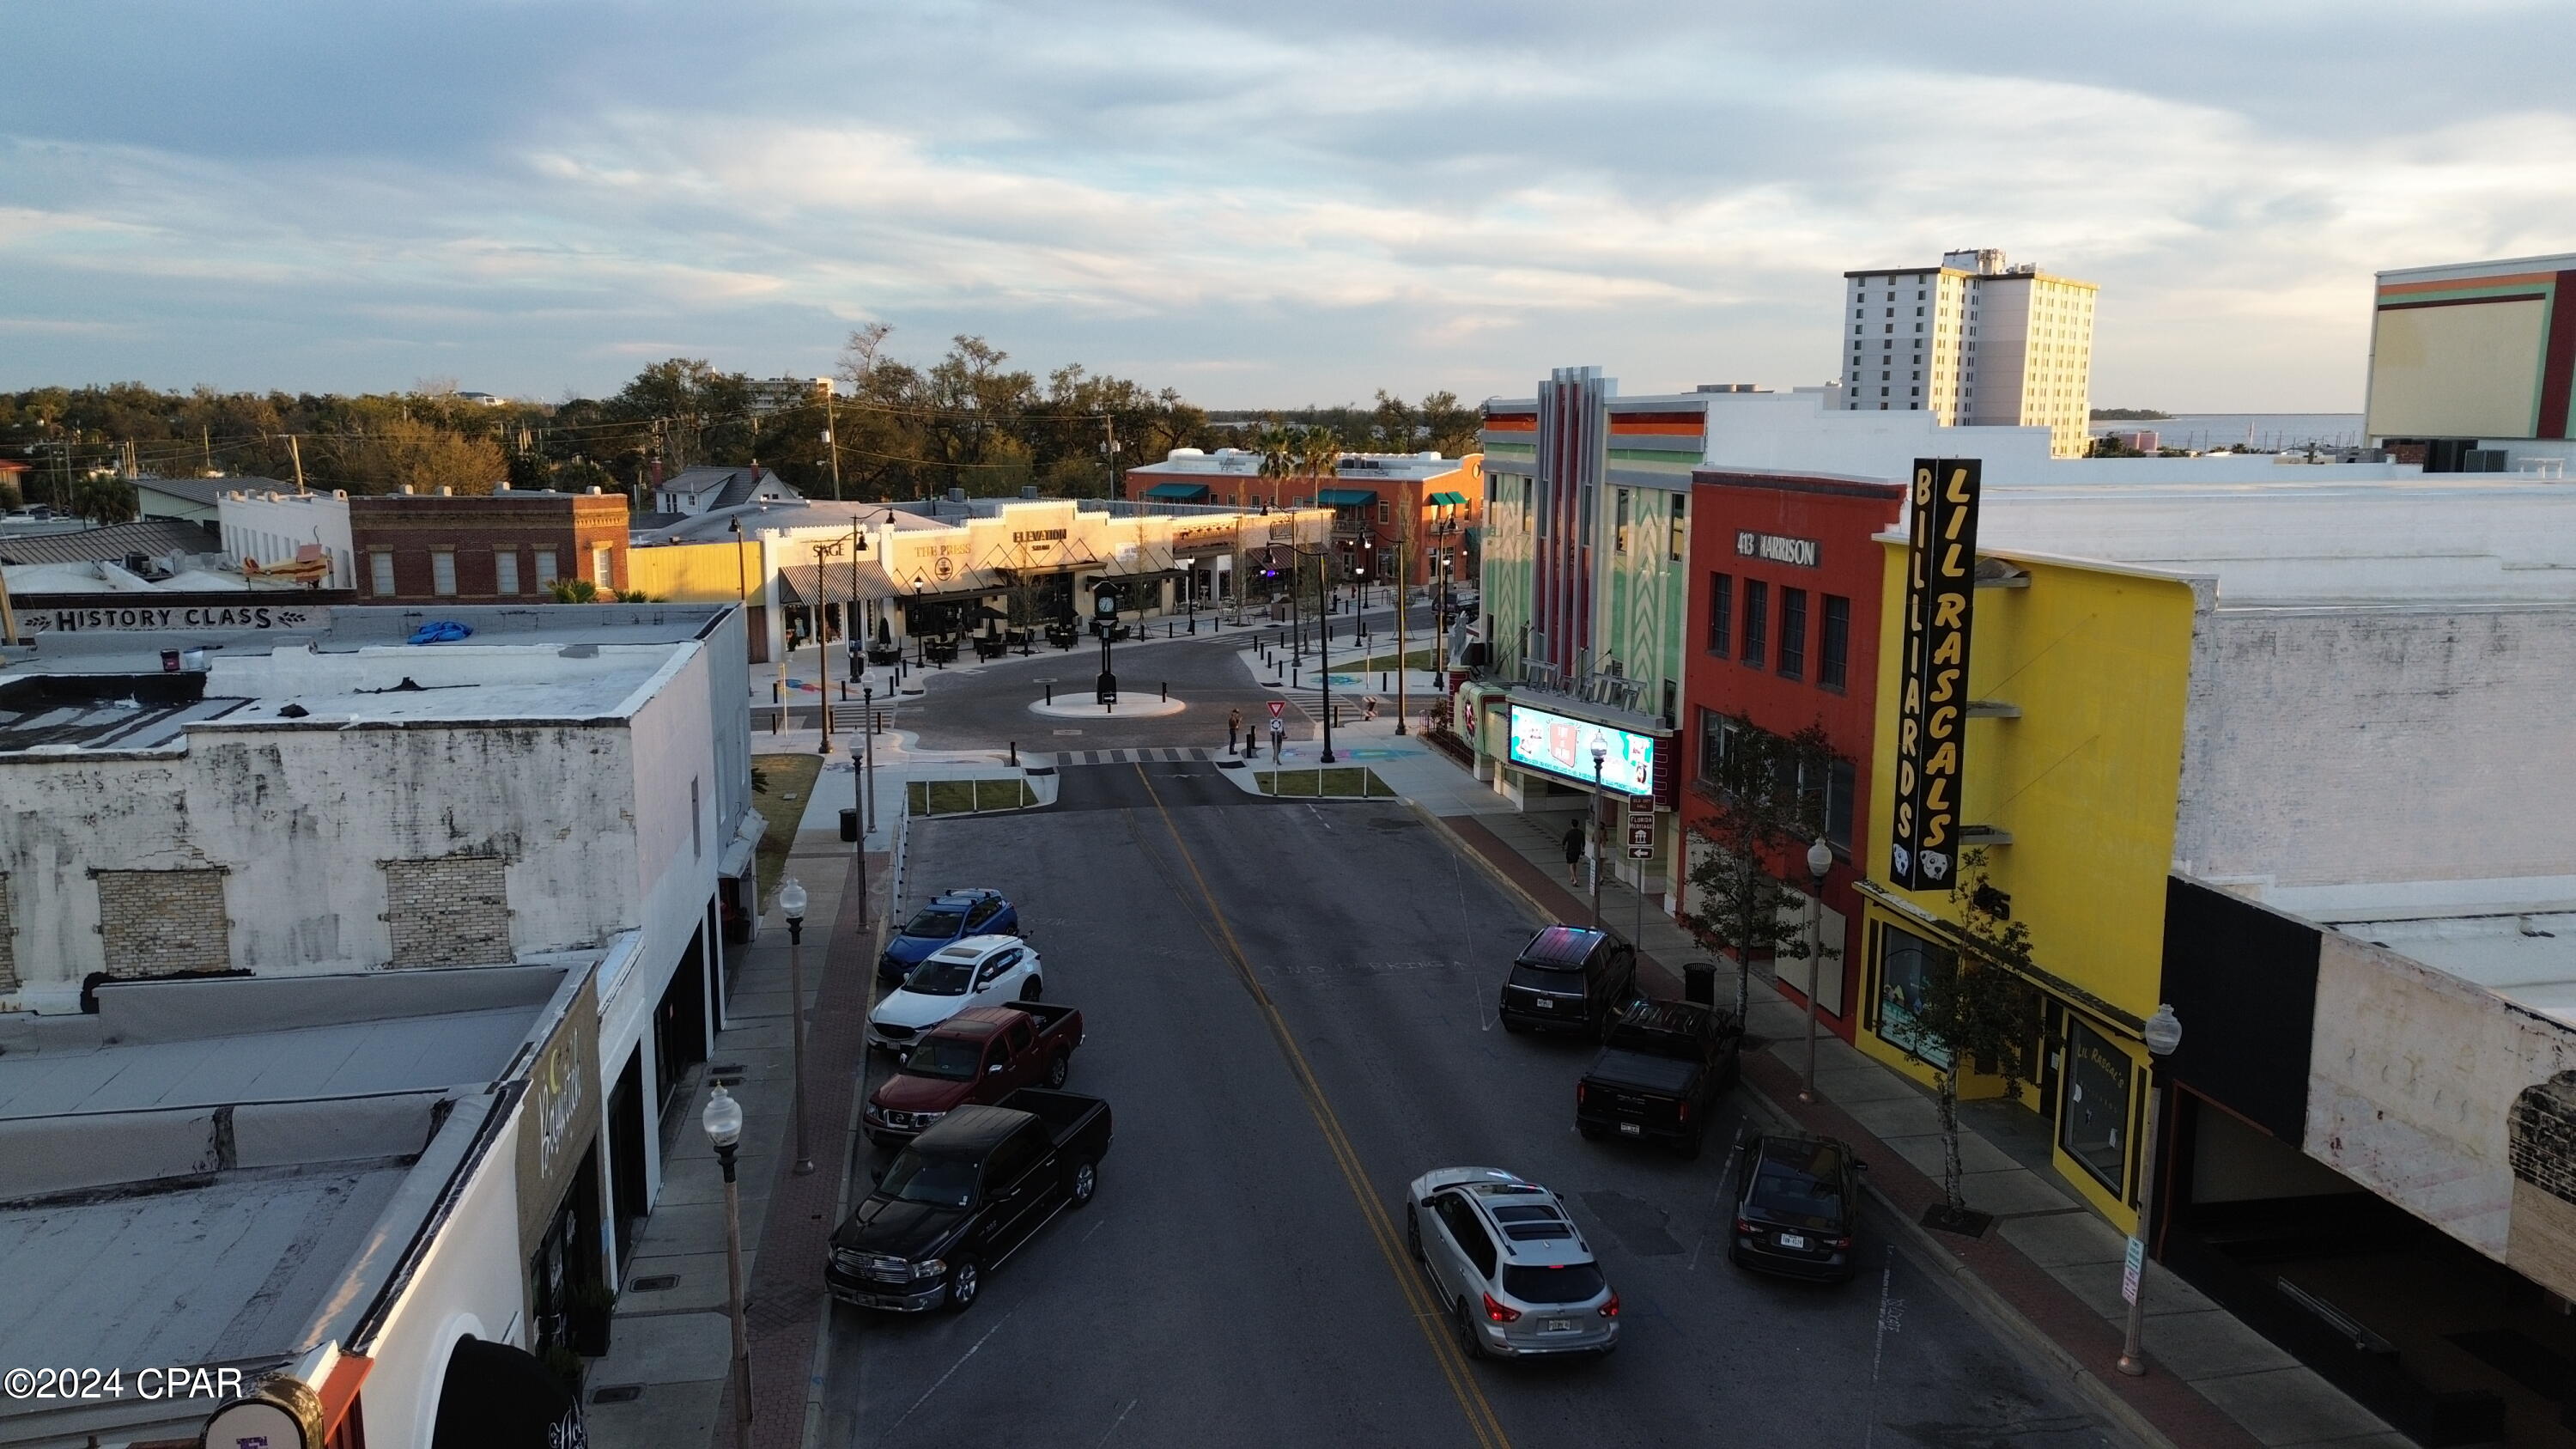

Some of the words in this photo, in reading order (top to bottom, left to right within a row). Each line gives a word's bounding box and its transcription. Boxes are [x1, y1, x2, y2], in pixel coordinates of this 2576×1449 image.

[1012, 528, 1067, 543] ELEVATION
[1941, 468, 1971, 577] LIL
[812, 543, 845, 557] SAGE
[914, 545, 938, 557] THE
[940, 543, 971, 556] PRESS
[1737, 532, 1754, 556] 413
[1759, 534, 1815, 565] HARRISON
[57, 609, 171, 631] HISTORY
[185, 607, 271, 630] CLASS
[1898, 467, 1931, 839] BILLIARDS
[1923, 593, 1966, 849] RASCALS
[2076, 1044, 2088, 1059] LIL
[2091, 1047, 2124, 1089] RASCAL'S
